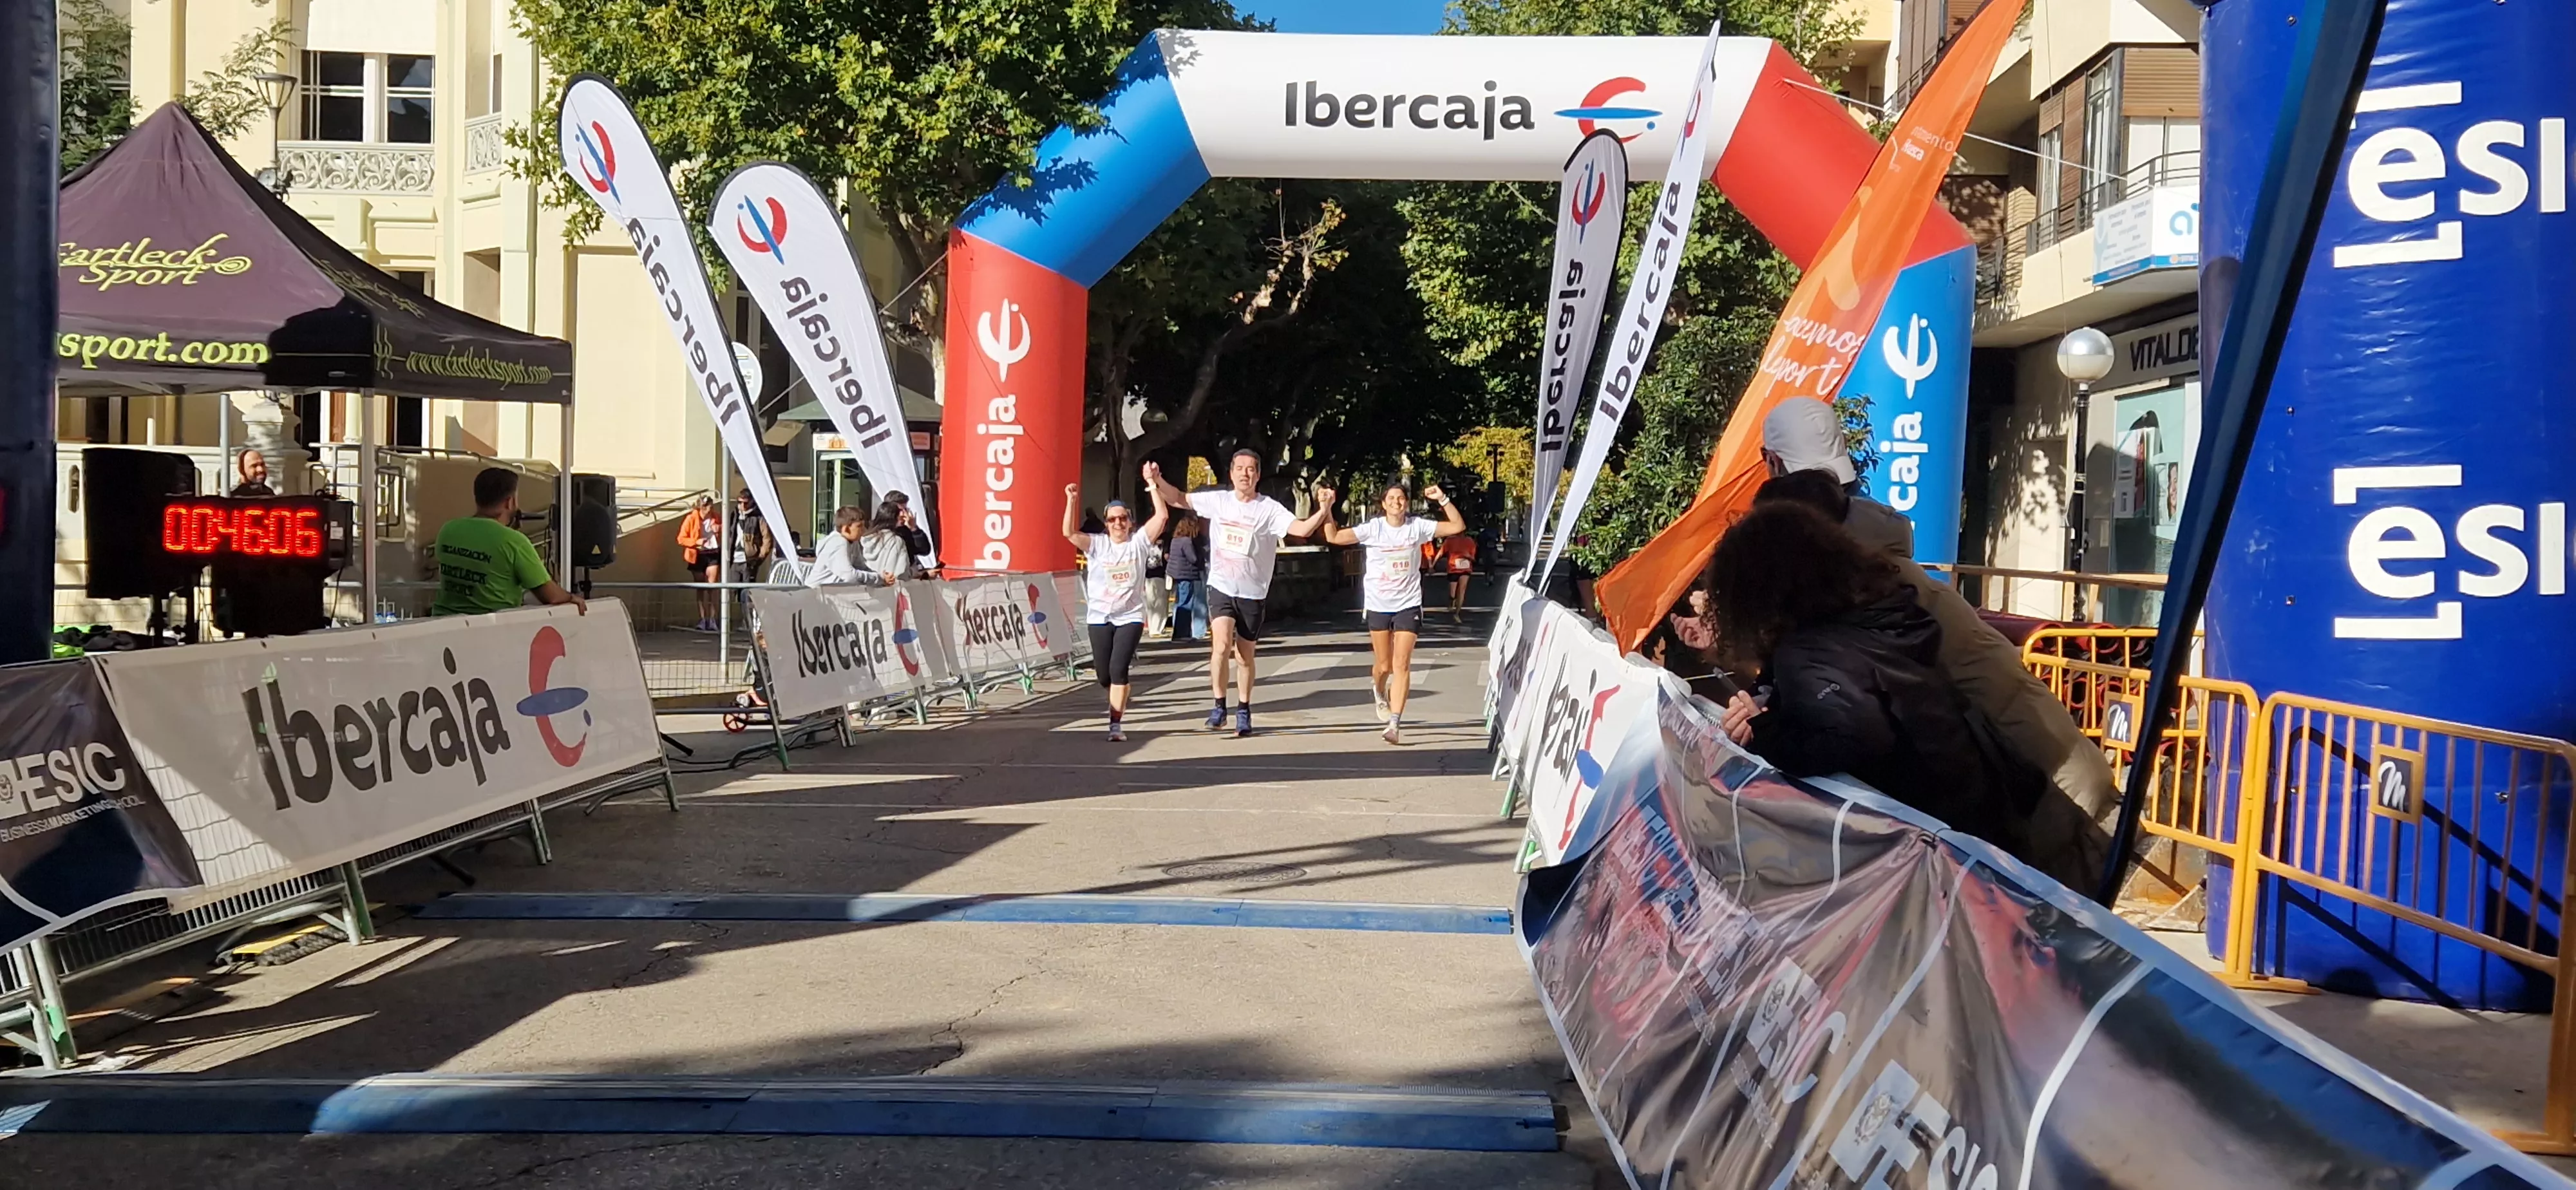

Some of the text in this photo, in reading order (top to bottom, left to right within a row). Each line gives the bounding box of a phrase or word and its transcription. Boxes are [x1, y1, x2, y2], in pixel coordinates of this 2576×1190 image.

[1285, 80, 1535, 141] Ibercaja
[79, 261, 211, 291] Sport
[1599, 181, 1681, 422] Ibercaja
[59, 332, 270, 370] sport.com
[406, 344, 552, 390] www.fartlecksport.com
[974, 394, 1024, 571] bercaja
[1880, 411, 1929, 515] caja
[792, 602, 887, 681] Ibercaja
[241, 647, 511, 811] Ibercaja
